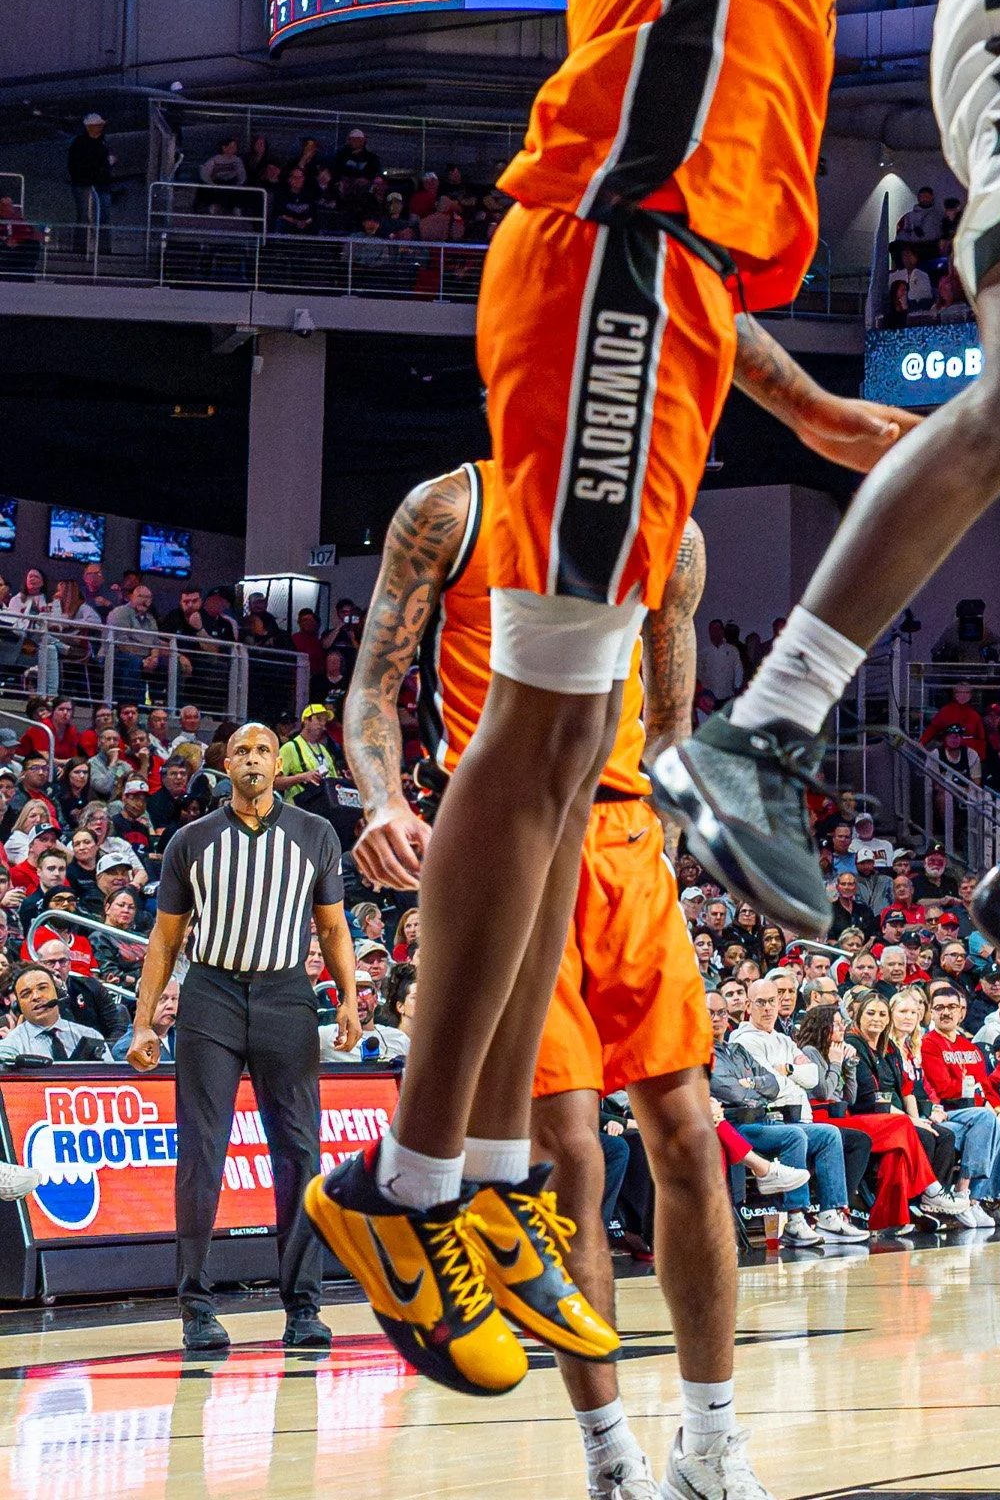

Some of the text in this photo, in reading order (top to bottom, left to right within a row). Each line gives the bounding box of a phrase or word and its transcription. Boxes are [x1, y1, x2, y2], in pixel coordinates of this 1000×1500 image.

[573, 308, 649, 505] COWBOYS
[310, 549, 334, 565] 107
[48, 1090, 154, 1126] ROTO-
[320, 1108, 391, 1142] XPERTS
[220, 1154, 256, 1191] OR
[229, 1227, 269, 1237] DAKTRONICS
